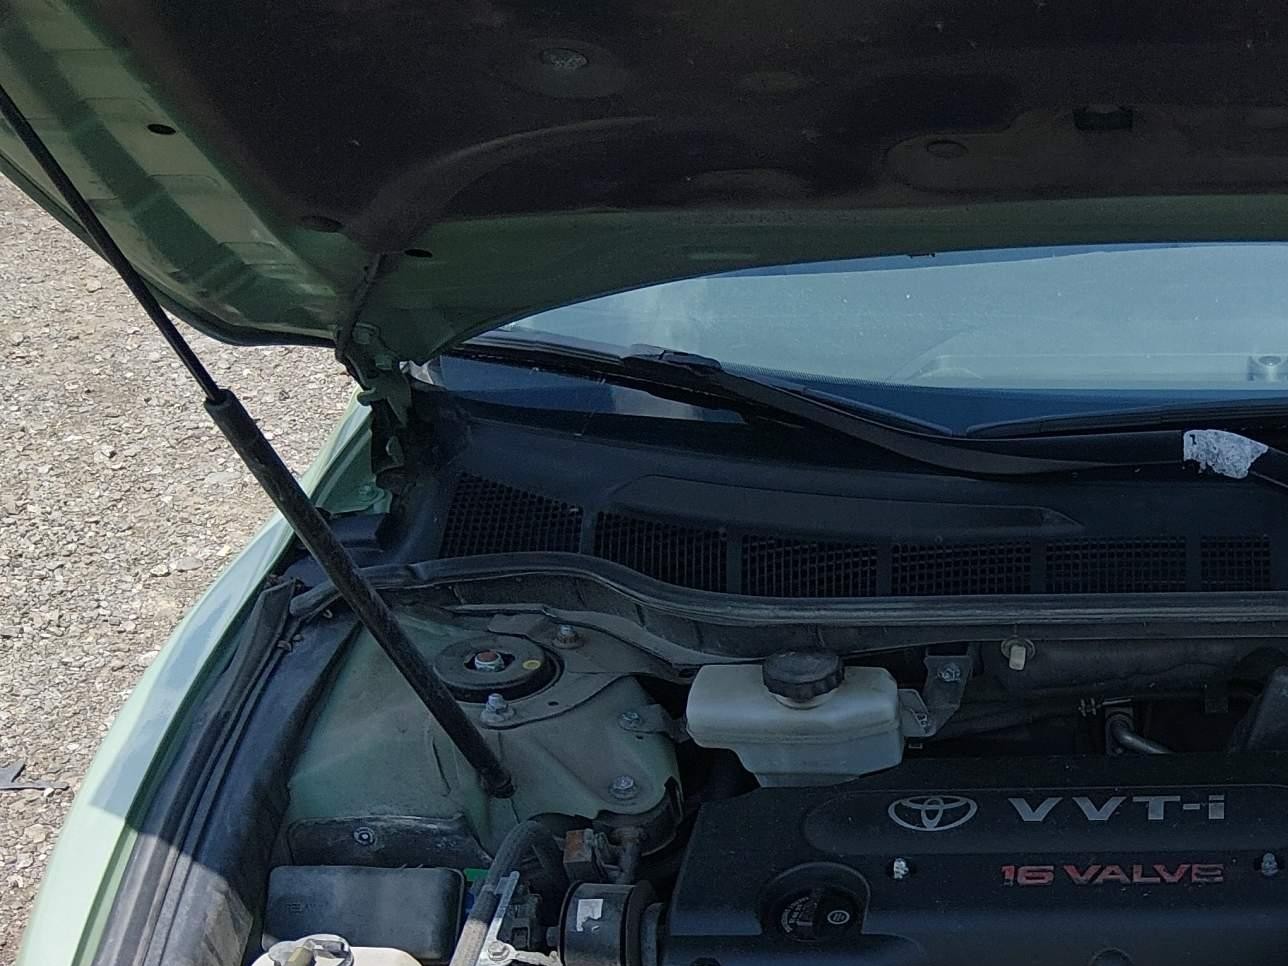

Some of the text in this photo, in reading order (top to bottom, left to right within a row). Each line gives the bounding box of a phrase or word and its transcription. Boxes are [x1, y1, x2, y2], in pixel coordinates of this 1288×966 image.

[1007, 794, 1225, 822] VVT-i
[1001, 864, 1225, 886] 16 VALVE
